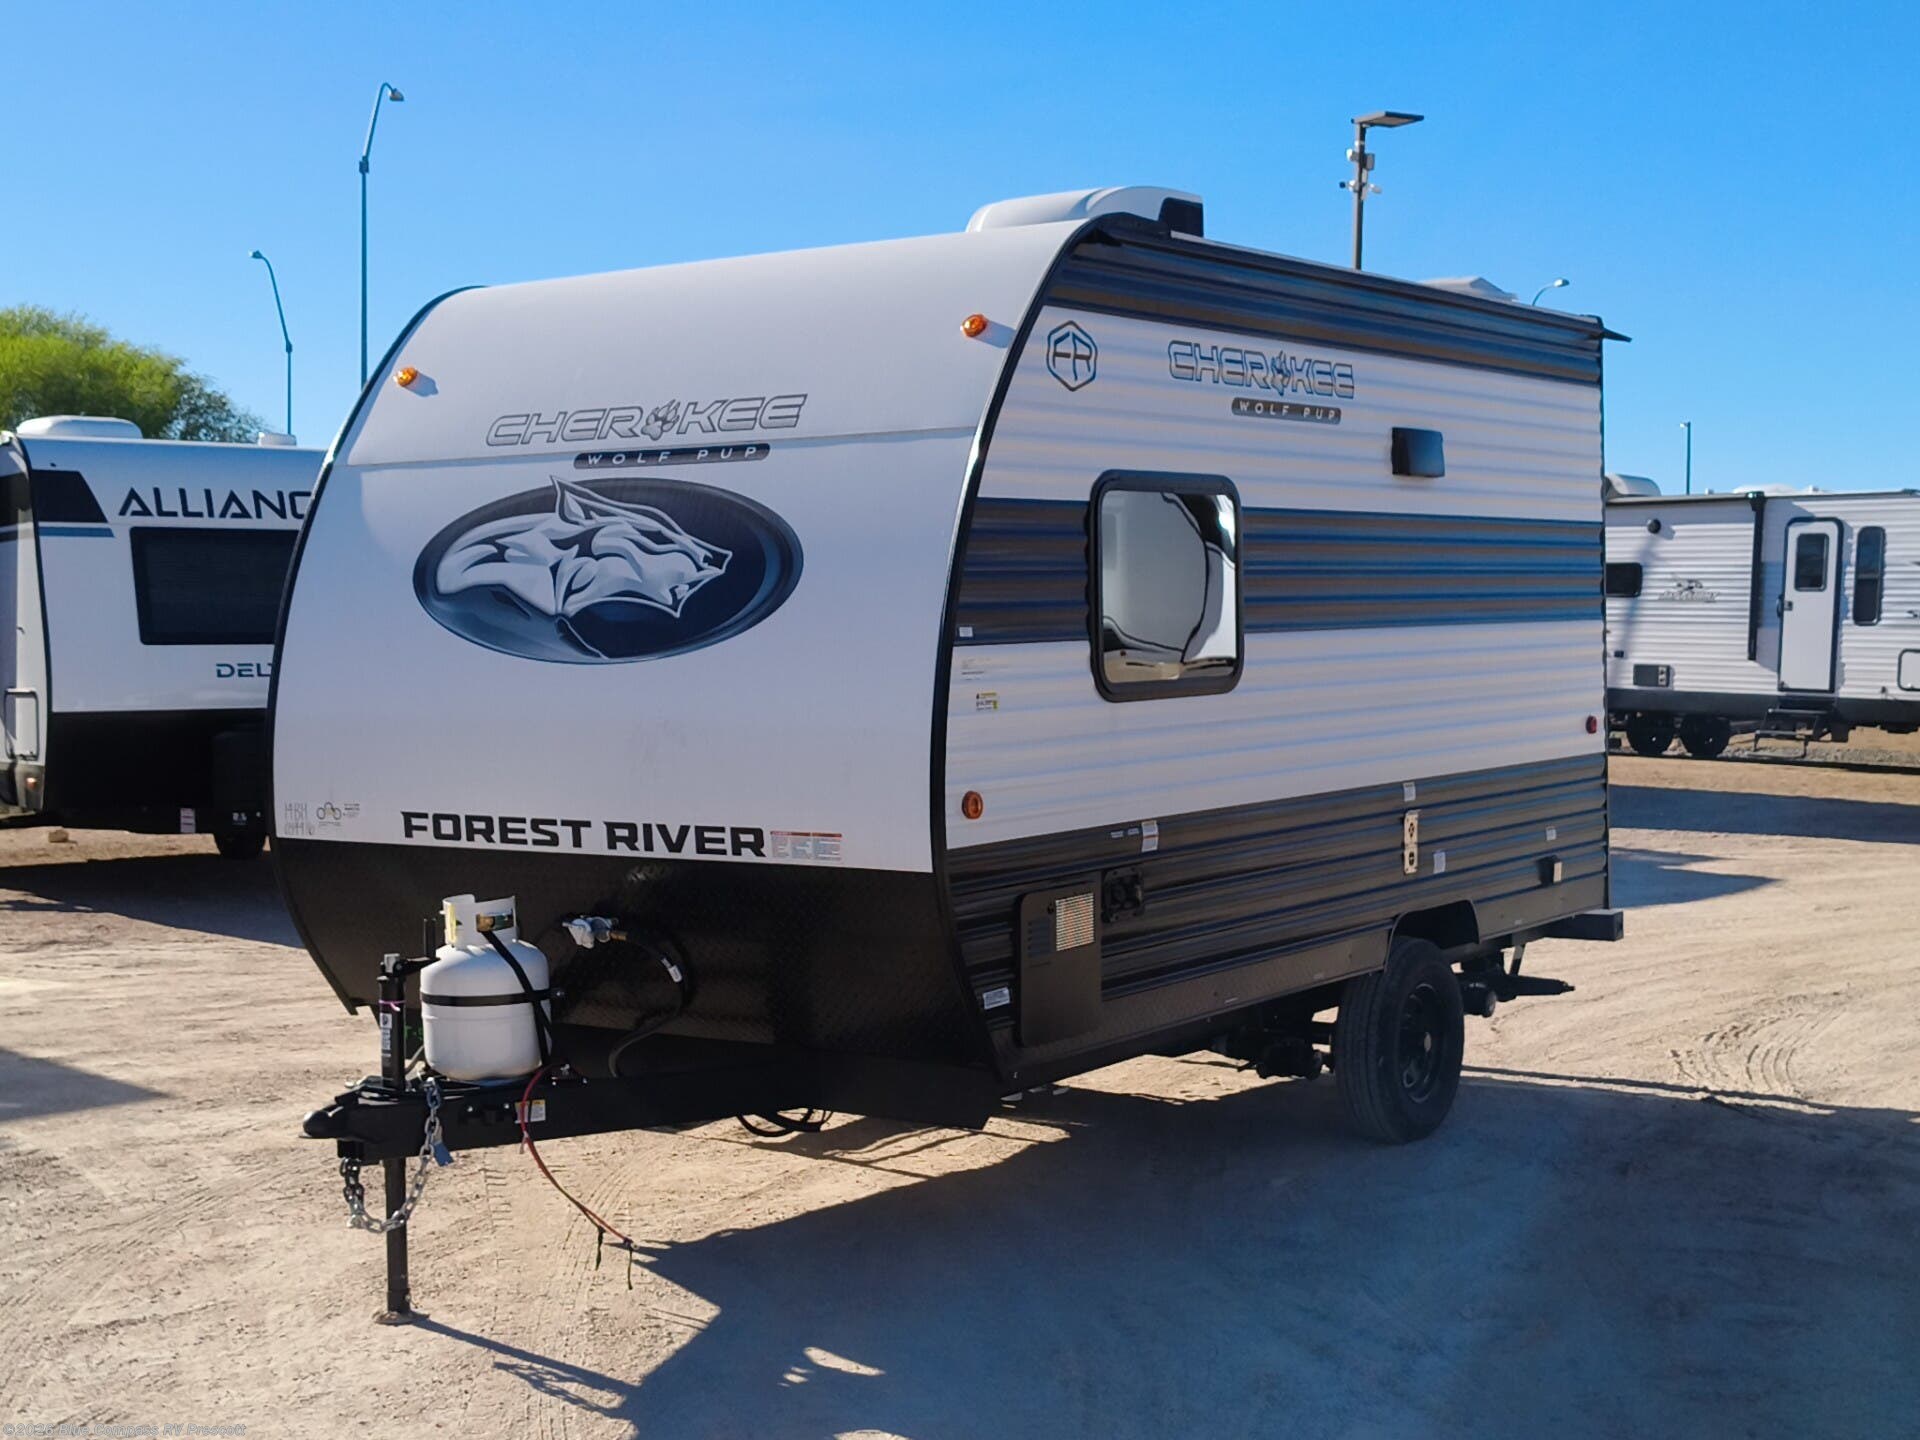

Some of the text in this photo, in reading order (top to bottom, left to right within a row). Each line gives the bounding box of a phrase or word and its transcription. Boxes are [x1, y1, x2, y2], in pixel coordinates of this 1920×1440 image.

[1239, 400, 1336, 421] WOLF PUP
[587, 446, 757, 466] WOLF PUP
[216, 662, 273, 678] DEL
[400, 811, 592, 848] FOREST
[603, 820, 767, 857] RIVER
